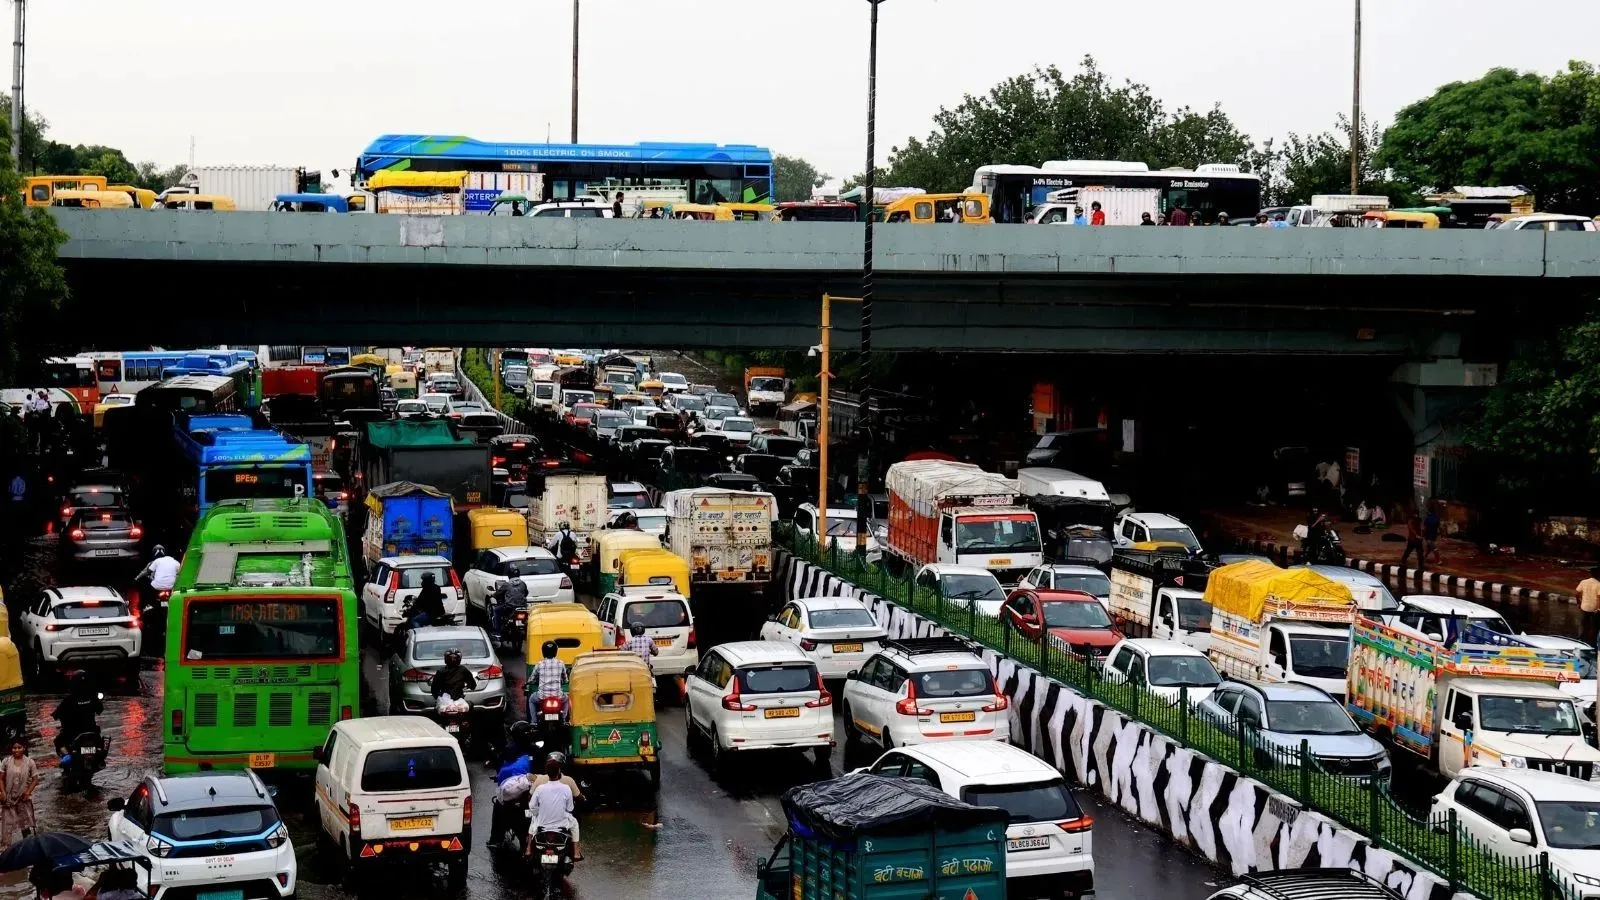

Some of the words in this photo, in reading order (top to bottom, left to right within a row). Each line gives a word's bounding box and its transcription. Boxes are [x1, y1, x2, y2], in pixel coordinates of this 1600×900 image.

[533, 149, 578, 157] ELECTRIC.
[597, 150, 633, 158] SMOKE.
[1170, 180, 1184, 188] Zero
[1184, 180, 1209, 188] Emission
[464, 192, 491, 200] ORTER
[235, 474, 258, 484] BPExp
